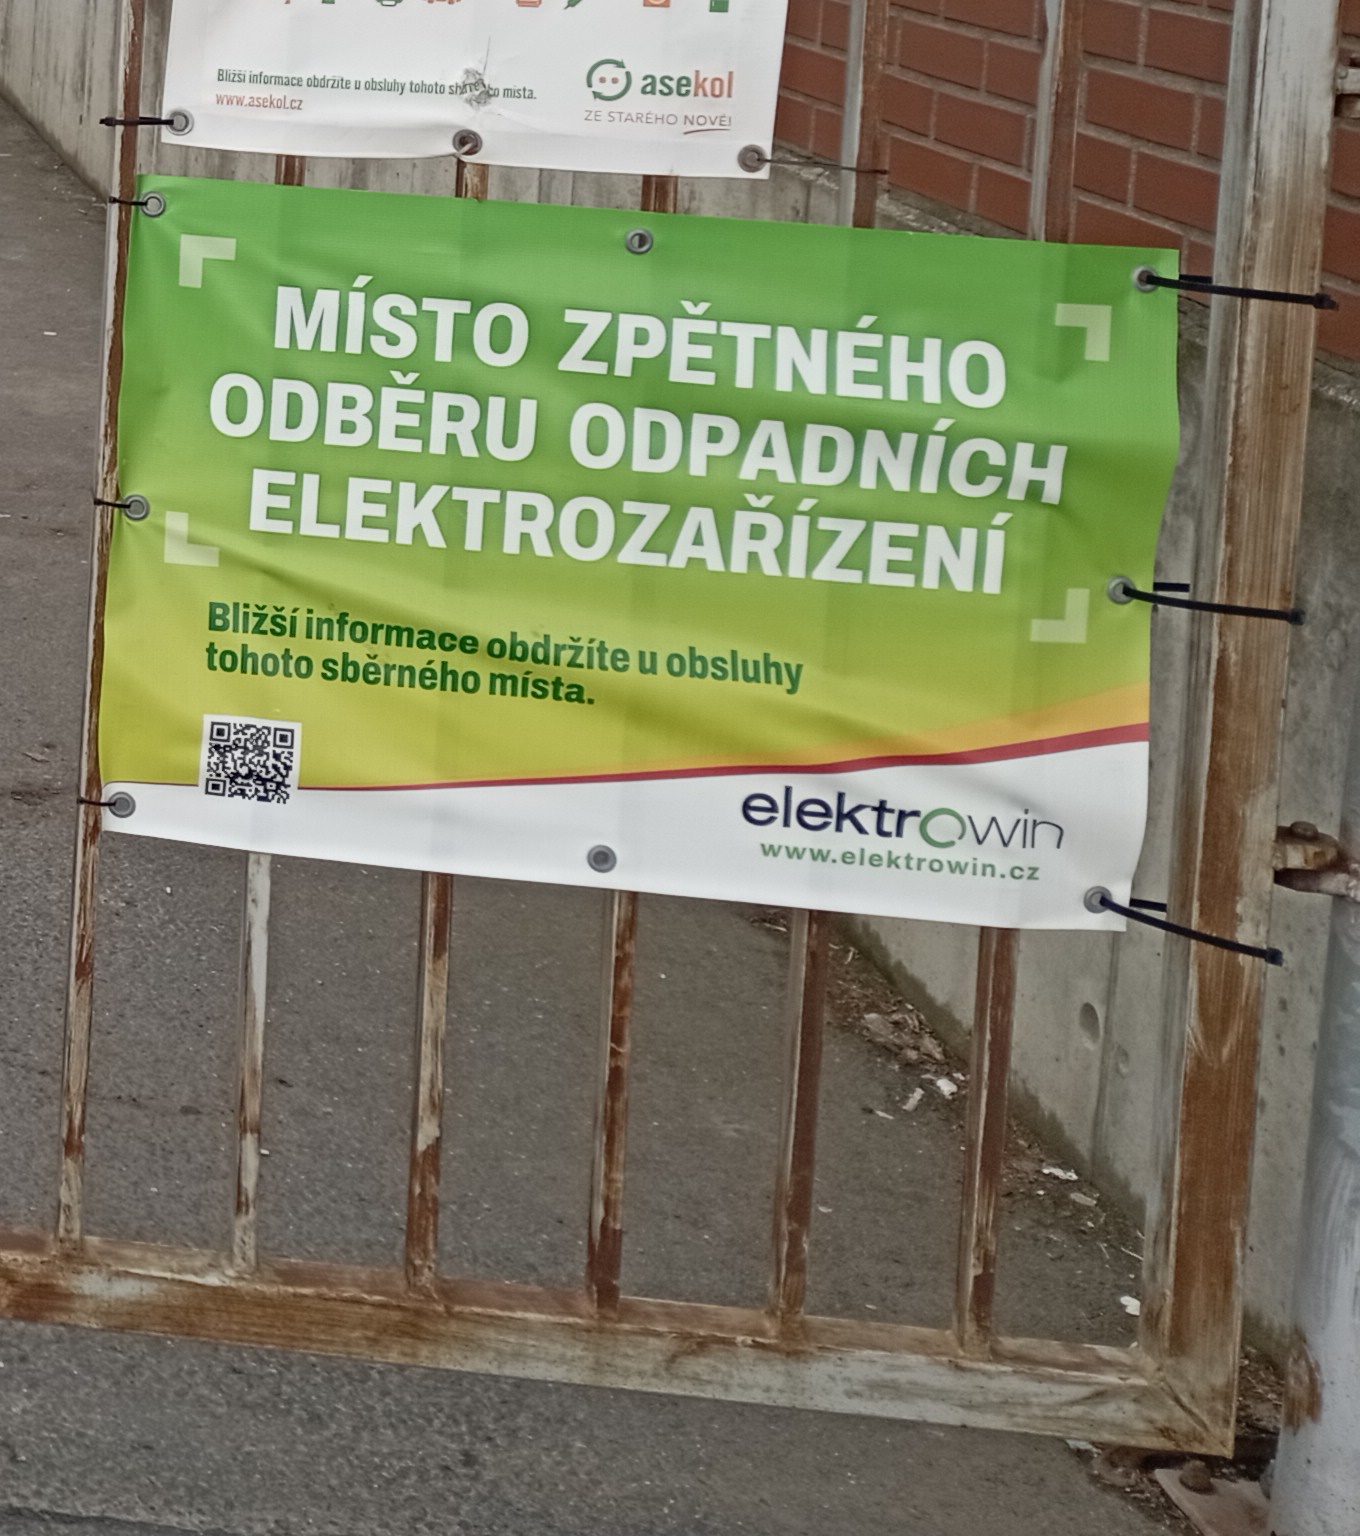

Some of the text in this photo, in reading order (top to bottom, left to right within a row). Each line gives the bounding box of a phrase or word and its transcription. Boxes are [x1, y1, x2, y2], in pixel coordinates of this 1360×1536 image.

[215, 92, 303, 110] www.asekol.cz
[217, 68, 246, 83] Bližší
[248, 70, 303, 87] informace
[306, 75, 352, 90] obdržíte
[355, 80, 361, 90] u
[364, 77, 407, 95] obsluhy
[409, 80, 445, 95] tohoto
[502, 85, 537, 99] místa.
[640, 69, 734, 98] asekol
[584, 109, 732, 127] ZE STARÉHO NOVÉ!
[274, 275, 1007, 409] MÍSTO ZPĚTNÉHO
[209, 370, 1068, 505] ODBĚRU ODPADNÍCH
[249, 468, 1014, 595] ELEKTROZAŘÍZENÍ
[206, 642, 595, 705] tohoto sběrného místa.
[208, 601, 804, 695] Bližší informace obdržíte u obsluhy
[741, 785, 1064, 850] elektrowin
[760, 842, 1041, 881] www.elektrowin.cz
